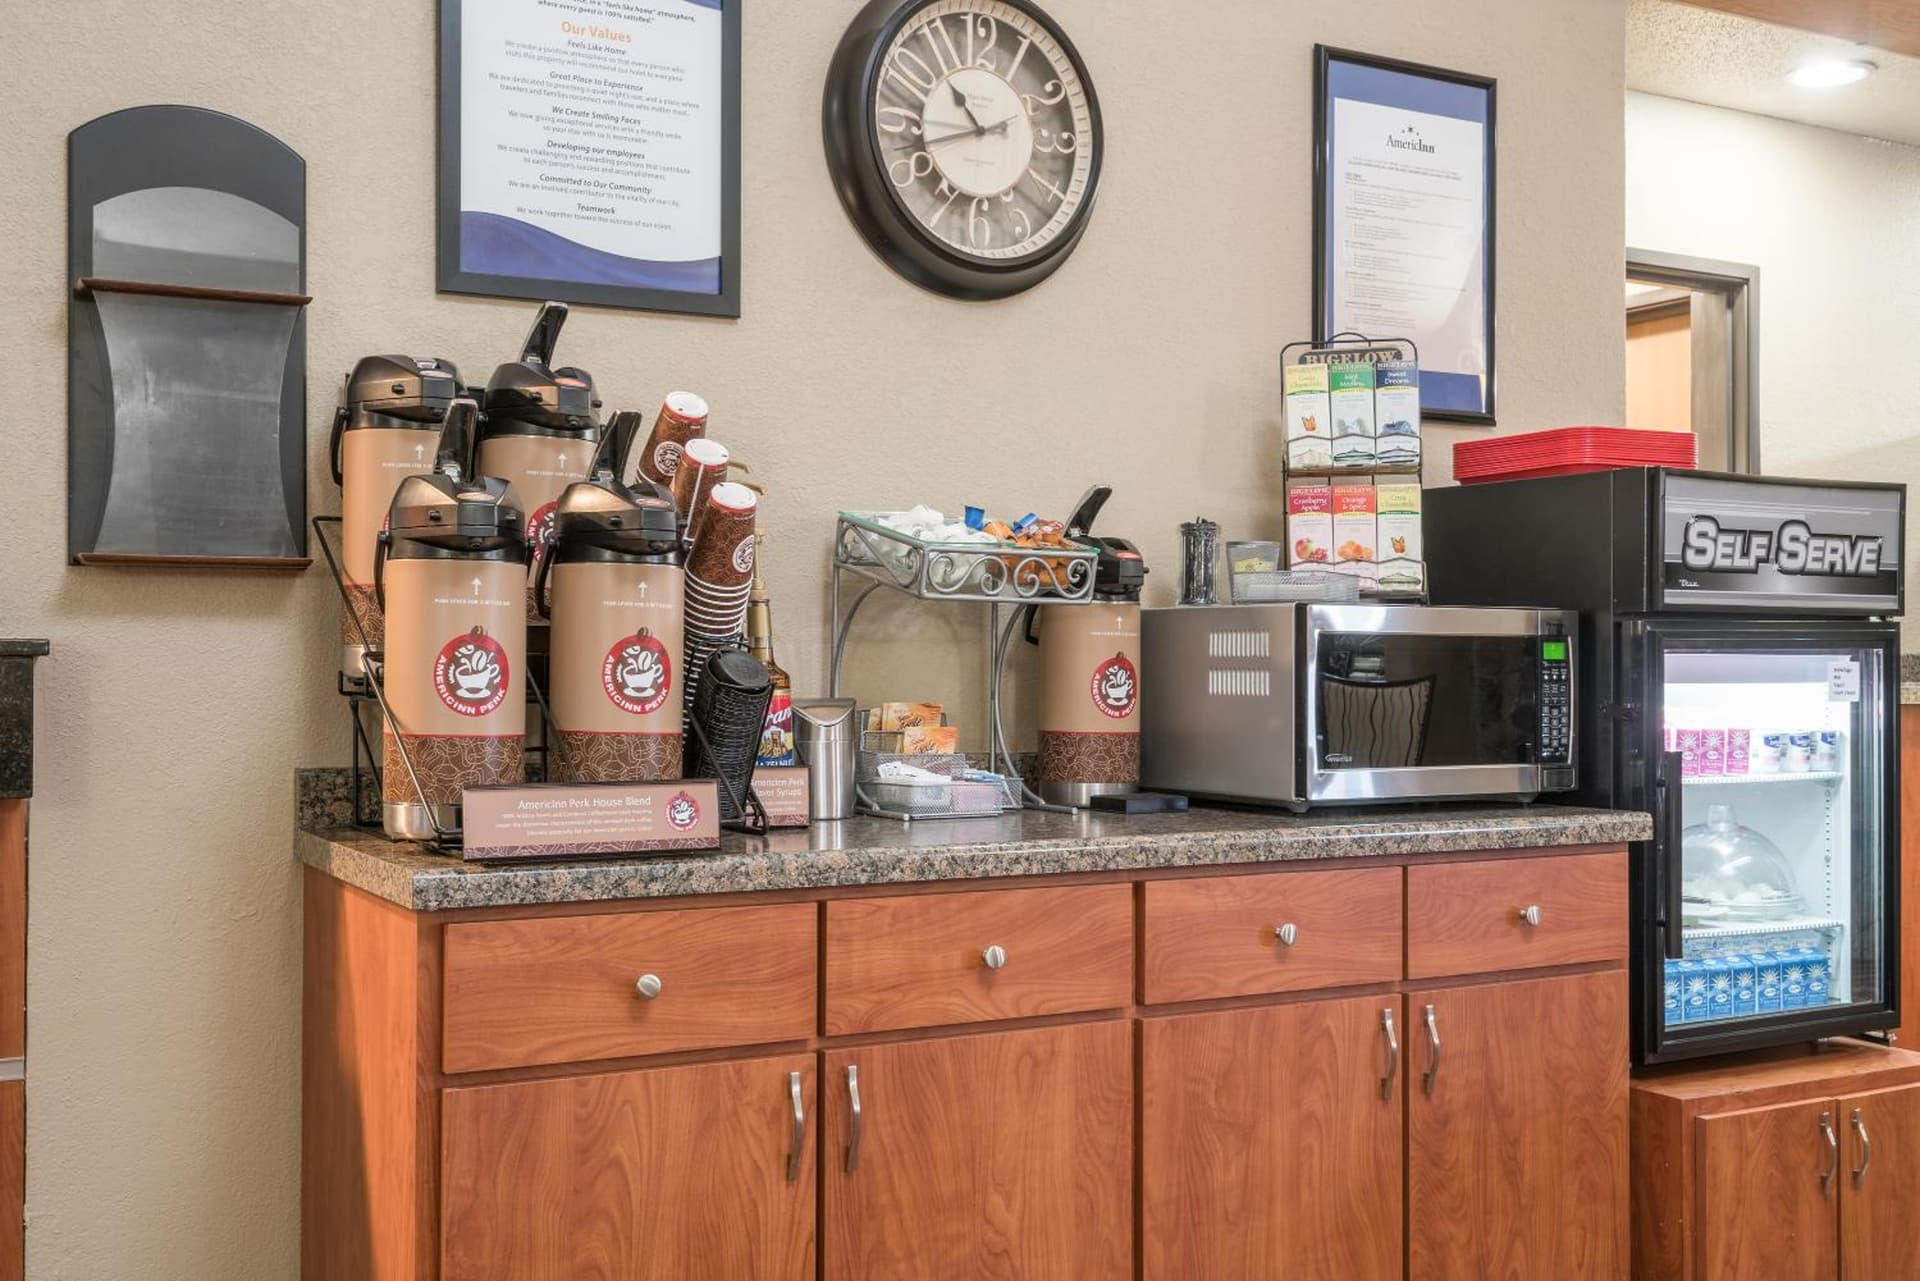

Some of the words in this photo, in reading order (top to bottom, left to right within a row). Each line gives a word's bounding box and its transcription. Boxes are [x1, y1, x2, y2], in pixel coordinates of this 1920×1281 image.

[560, 19, 584, 35] Our
[589, 24, 632, 44] Values
[567, 39, 585, 49] Feels
[587, 42, 602, 52] Like
[604, 45, 626, 55] Home
[916, 17, 962, 75] 11
[960, 13, 997, 72] 12
[886, 47, 937, 103] 10
[1006, 35, 1031, 82] 1
[550, 71, 570, 81] Great
[573, 74, 592, 84] Place
[594, 77, 602, 85] to
[604, 78, 643, 91] Experience
[1022, 79, 1066, 116] 2
[552, 105, 563, 114] We
[564, 107, 589, 118] Create
[592, 111, 619, 123] Smiling
[621, 115, 641, 125] Faces
[878, 106, 924, 135] 9
[547, 140, 590, 154] Developing
[606, 148, 645, 159] employees
[1035, 129, 1078, 153] 3
[1386, 134, 1436, 154] AmericInn
[539, 174, 582, 186] Committed
[583, 179, 592, 187] to
[593, 180, 607, 188] Our
[608, 182, 652, 195] Community
[889, 151, 933, 188] 8
[1028, 167, 1065, 202] 4
[577, 202, 615, 214] Teamwork
[930, 178, 960, 228] 7
[1000, 187, 1031, 242] 5
[969, 197, 990, 247] 6
[1303, 350, 1396, 364] BIGELOW
[1684, 516, 1772, 573] SELF
[1778, 521, 1881, 576] SERVE
[436, 655, 476, 714] AMERICINN
[480, 688, 505, 714] PERK
[604, 654, 642, 712] AMERICINN
[644, 688, 668, 712] PERK
[569, 798, 590, 808] Perk
[592, 798, 623, 808] House
[624, 796, 652, 806] Blend
